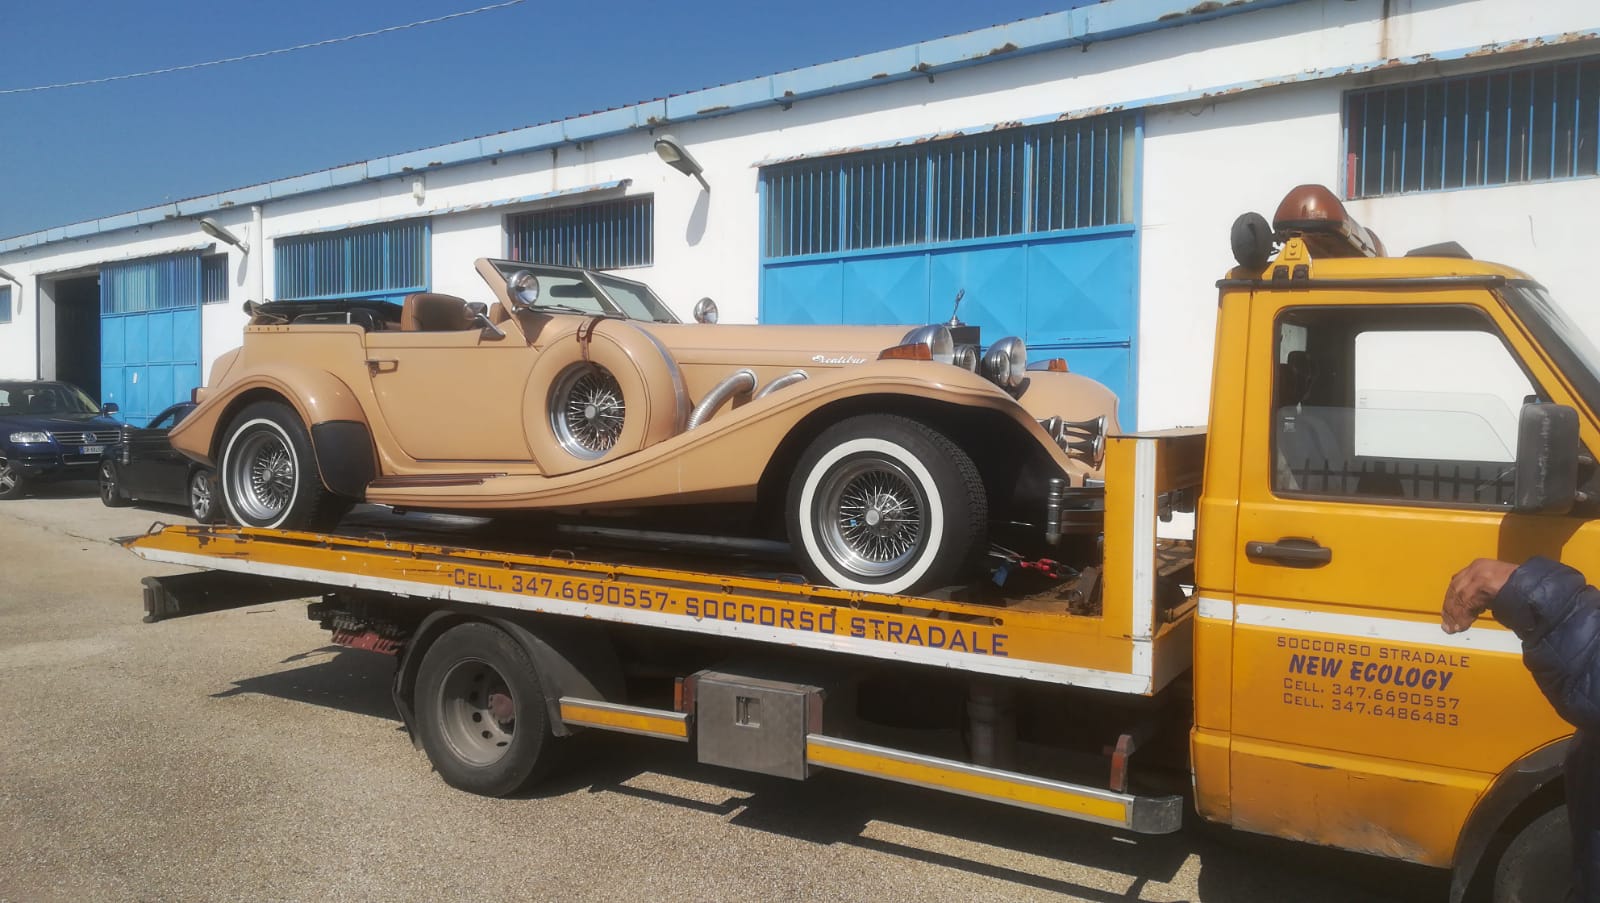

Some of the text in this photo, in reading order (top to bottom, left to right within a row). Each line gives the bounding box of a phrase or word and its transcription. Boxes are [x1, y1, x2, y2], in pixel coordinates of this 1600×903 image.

[686, 597, 835, 634] SOCCORSO
[850, 617, 1008, 656] STRADALE
[1277, 636, 1471, 668] SOCCORSO STRADALE
[1288, 654, 1453, 691] NEW ECOLOGY
[1331, 699, 1459, 726] 347.6486483
[1332, 683, 1460, 710] 347.6690557
